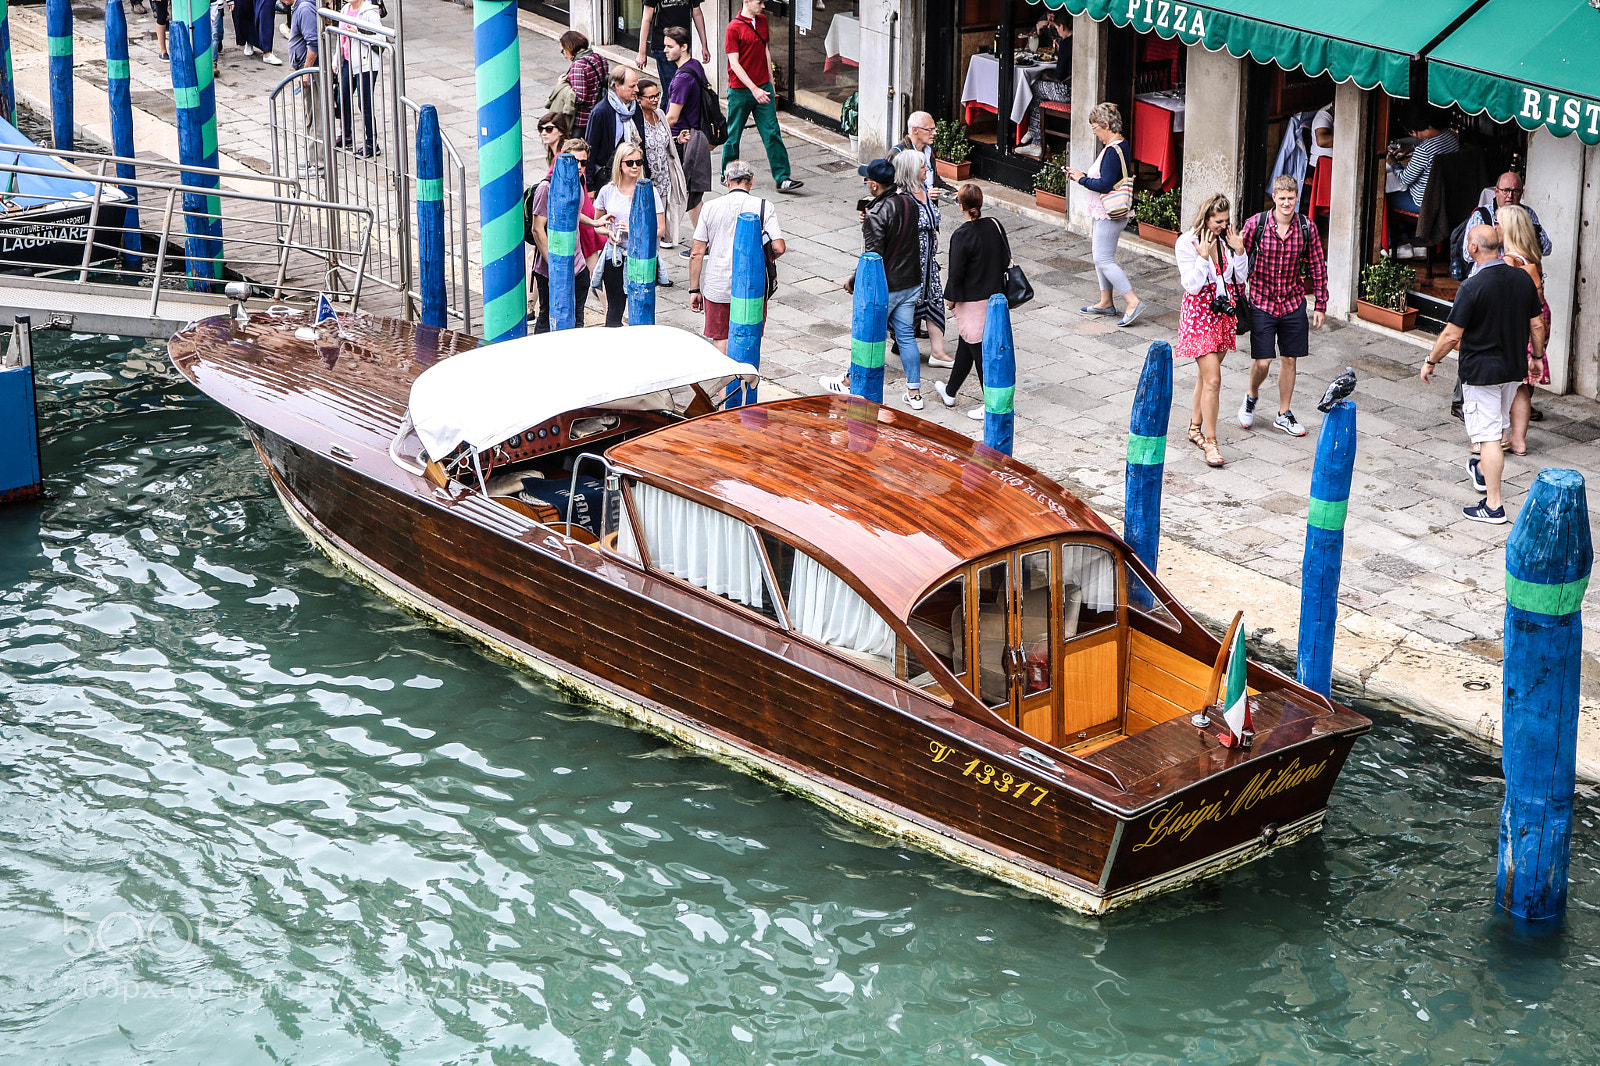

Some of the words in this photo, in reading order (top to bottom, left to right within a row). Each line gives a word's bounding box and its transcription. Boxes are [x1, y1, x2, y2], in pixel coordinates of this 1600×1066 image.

[1125, 0, 1206, 37] PIZZA
[1519, 87, 1600, 135] RIST
[2, 222, 90, 253] LAGUNARE
[929, 740, 956, 763] V
[962, 759, 1050, 807] 13317
